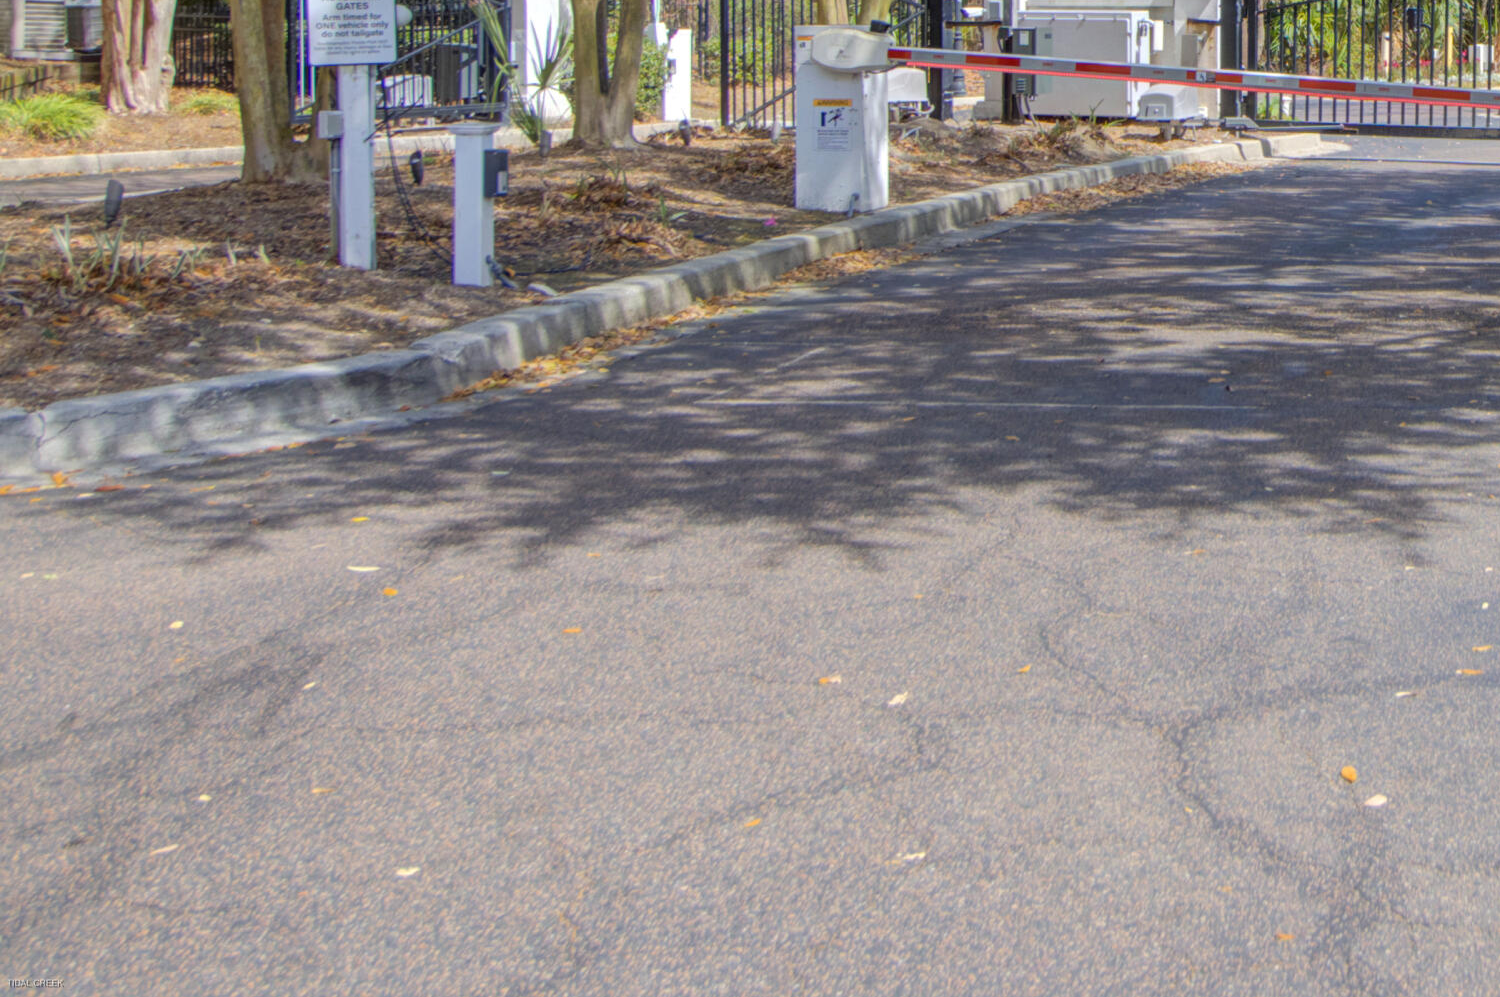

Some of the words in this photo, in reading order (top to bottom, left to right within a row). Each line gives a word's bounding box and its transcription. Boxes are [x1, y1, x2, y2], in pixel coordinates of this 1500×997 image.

[335, 2, 369, 11] GATES
[315, 22, 336, 30] ONE
[371, 21, 389, 30] only
[321, 30, 333, 38] do
[351, 29, 384, 39] tailgate
